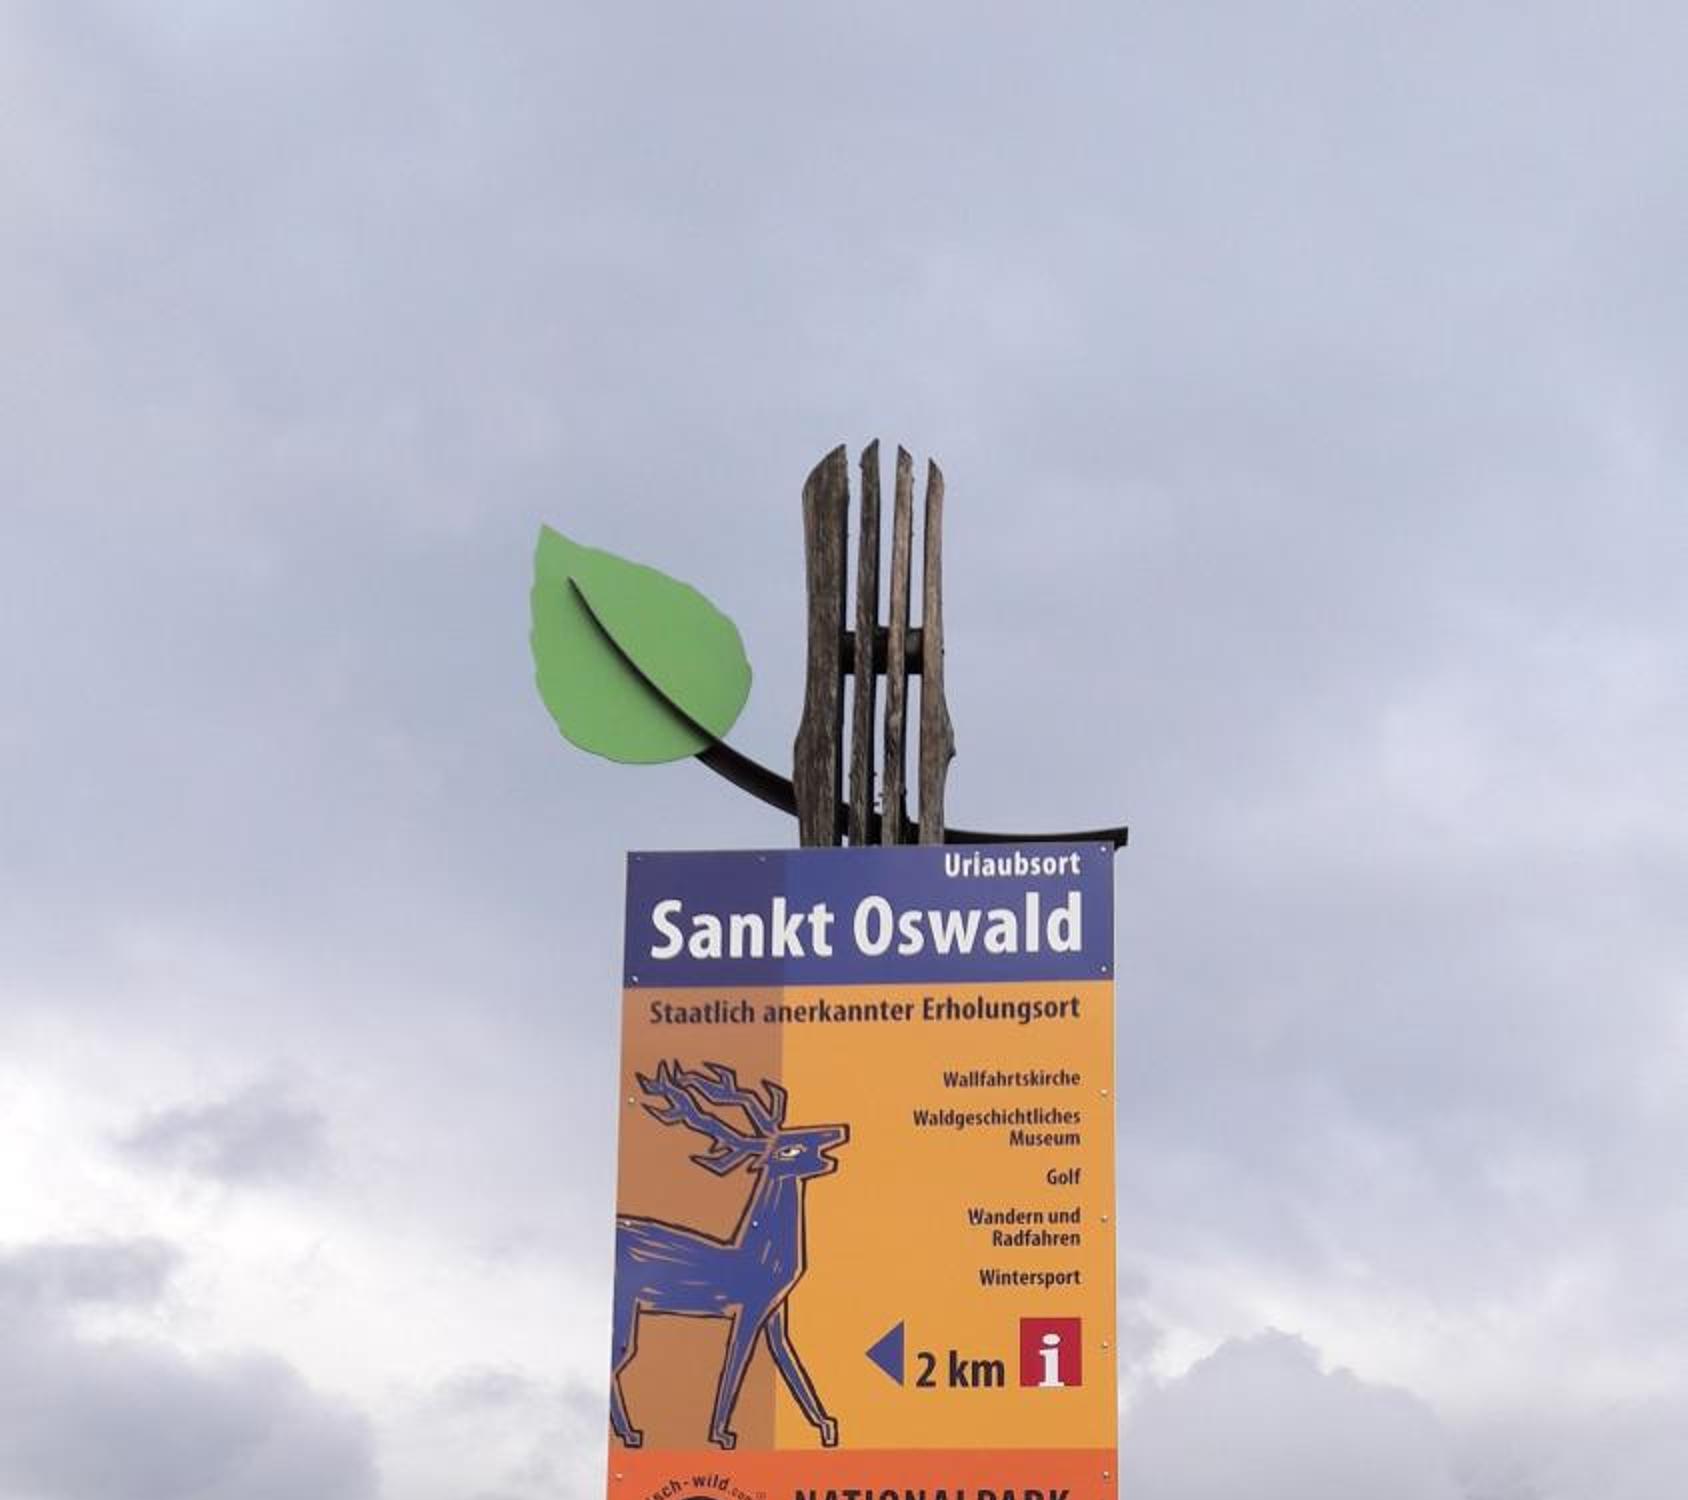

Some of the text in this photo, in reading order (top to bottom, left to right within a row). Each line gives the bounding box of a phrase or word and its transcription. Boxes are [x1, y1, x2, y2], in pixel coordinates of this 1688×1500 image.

[650, 890, 1082, 959] Sankt Oswald
[650, 995, 1080, 1025] Staatlich anerkannter Erholungsort
[943, 1069, 1081, 1088] Wallfahrtskirche
[913, 1108, 1081, 1130] Waldgeschichtliches
[1009, 1130, 1081, 1147] Museum
[1046, 1168, 1081, 1185] Golf
[968, 1206, 1081, 1225] Wandern und
[992, 1229, 1081, 1247] Radfahren
[979, 1269, 1081, 1289] Wintersport
[915, 1350, 1005, 1387] 2 km
